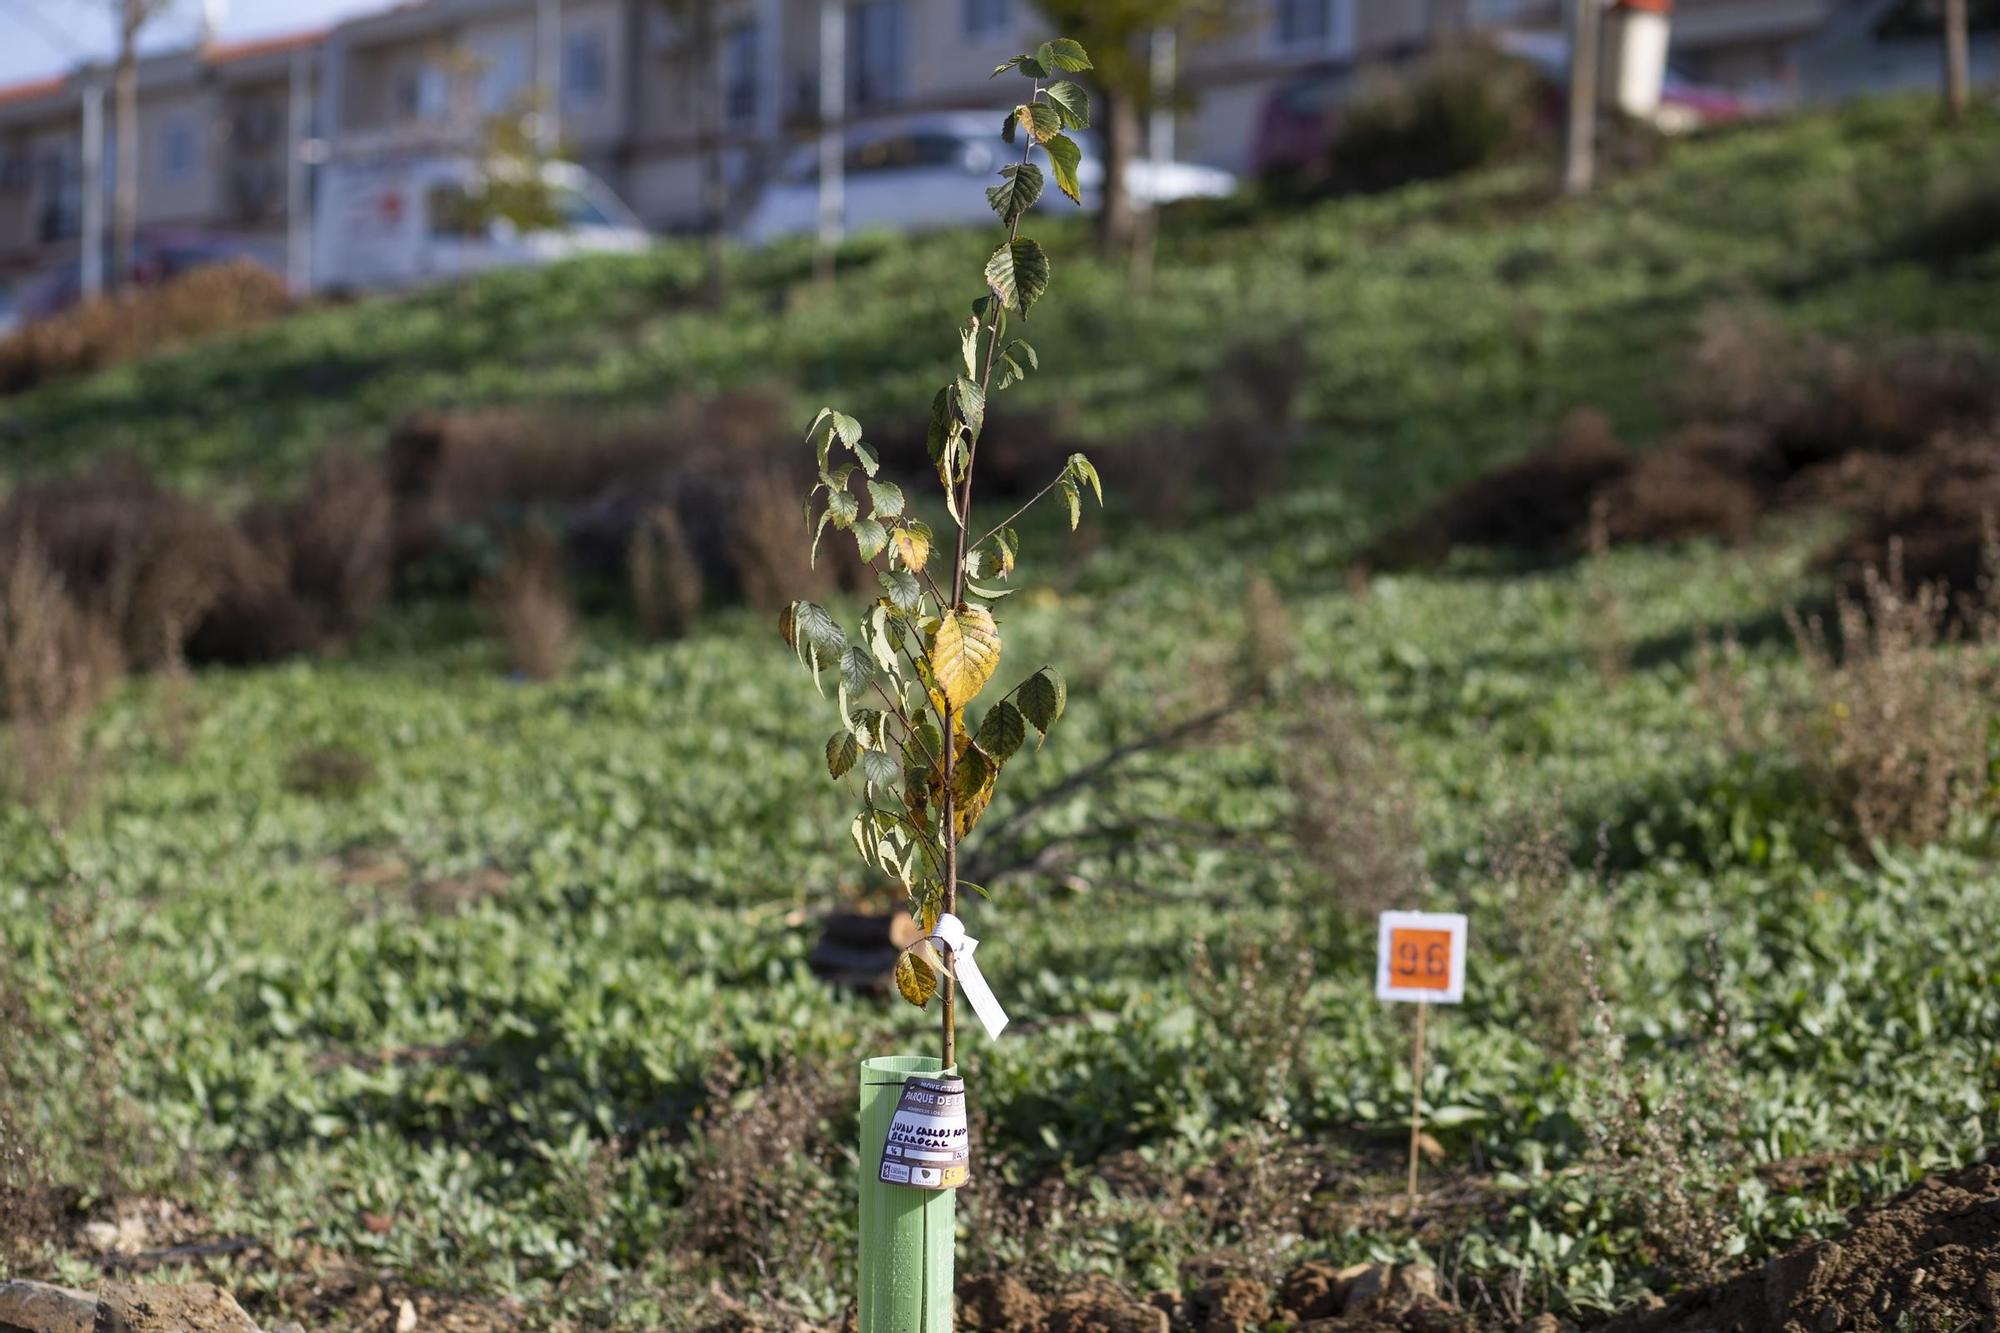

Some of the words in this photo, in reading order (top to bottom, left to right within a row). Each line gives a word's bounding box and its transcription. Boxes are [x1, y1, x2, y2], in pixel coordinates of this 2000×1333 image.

[1399, 941, 1444, 976] 96
[905, 1091, 934, 1104] PARQUE
[937, 1095, 952, 1106] DE
[892, 1122, 914, 1134] JUAN
[916, 1126, 950, 1138] CARLOS
[891, 1133, 948, 1148] BERROCAL
